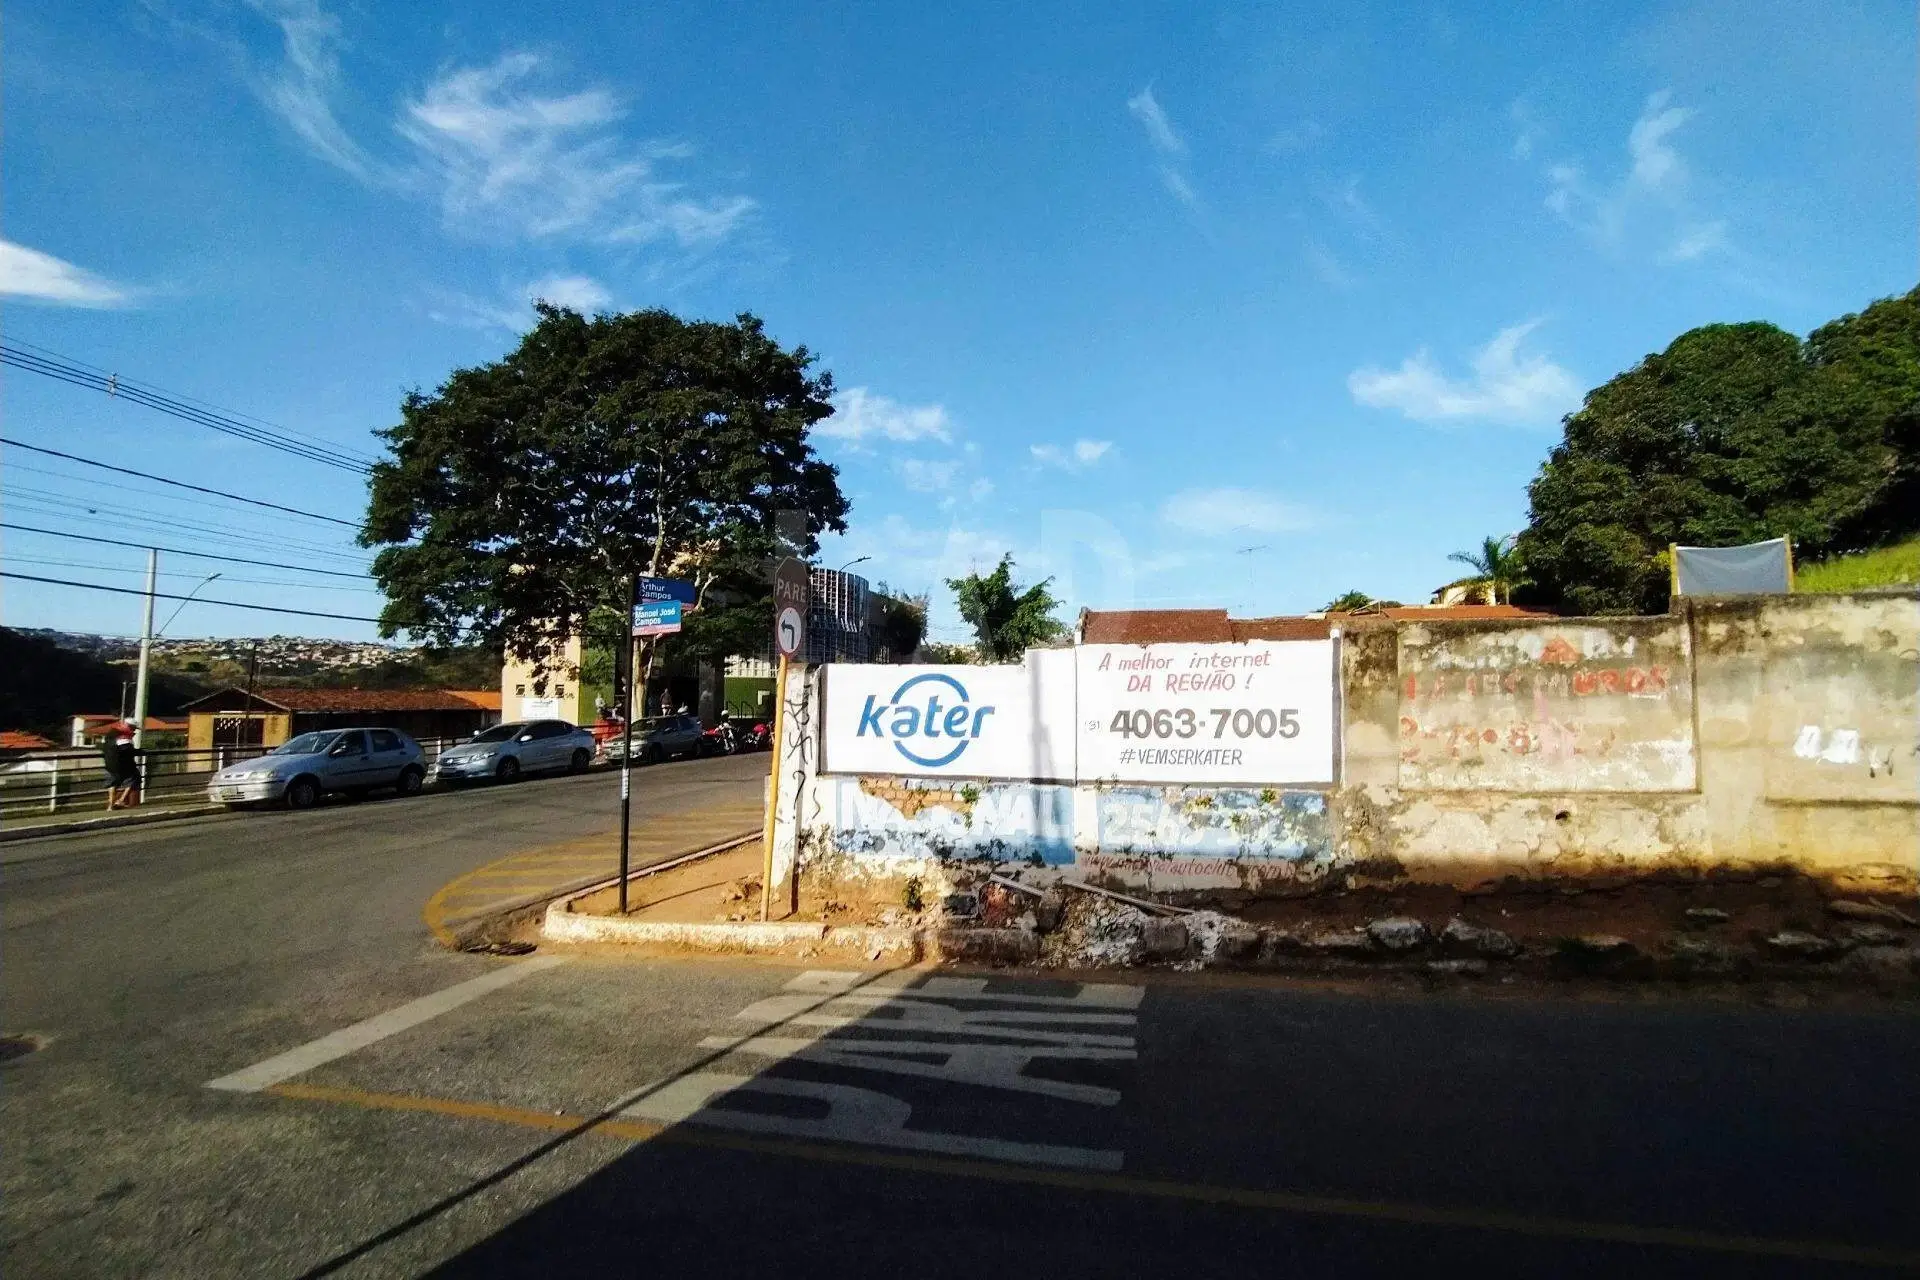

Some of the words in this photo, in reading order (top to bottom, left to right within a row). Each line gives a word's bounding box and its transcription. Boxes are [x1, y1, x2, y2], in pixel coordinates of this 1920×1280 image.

[639, 590, 672, 600] Campos
[640, 582, 665, 592] Arthur
[776, 578, 807, 600] PARE
[659, 607, 676, 617] José
[634, 617, 662, 627] Campos
[1098, 652, 1112, 671] A
[1118, 652, 1174, 671] melhor
[1189, 650, 1272, 669] internet
[1127, 674, 1152, 692] DA
[1166, 669, 1236, 694] REGIÃO
[856, 694, 995, 738] kater
[1119, 748, 1243, 766] #VEMSERKATER
